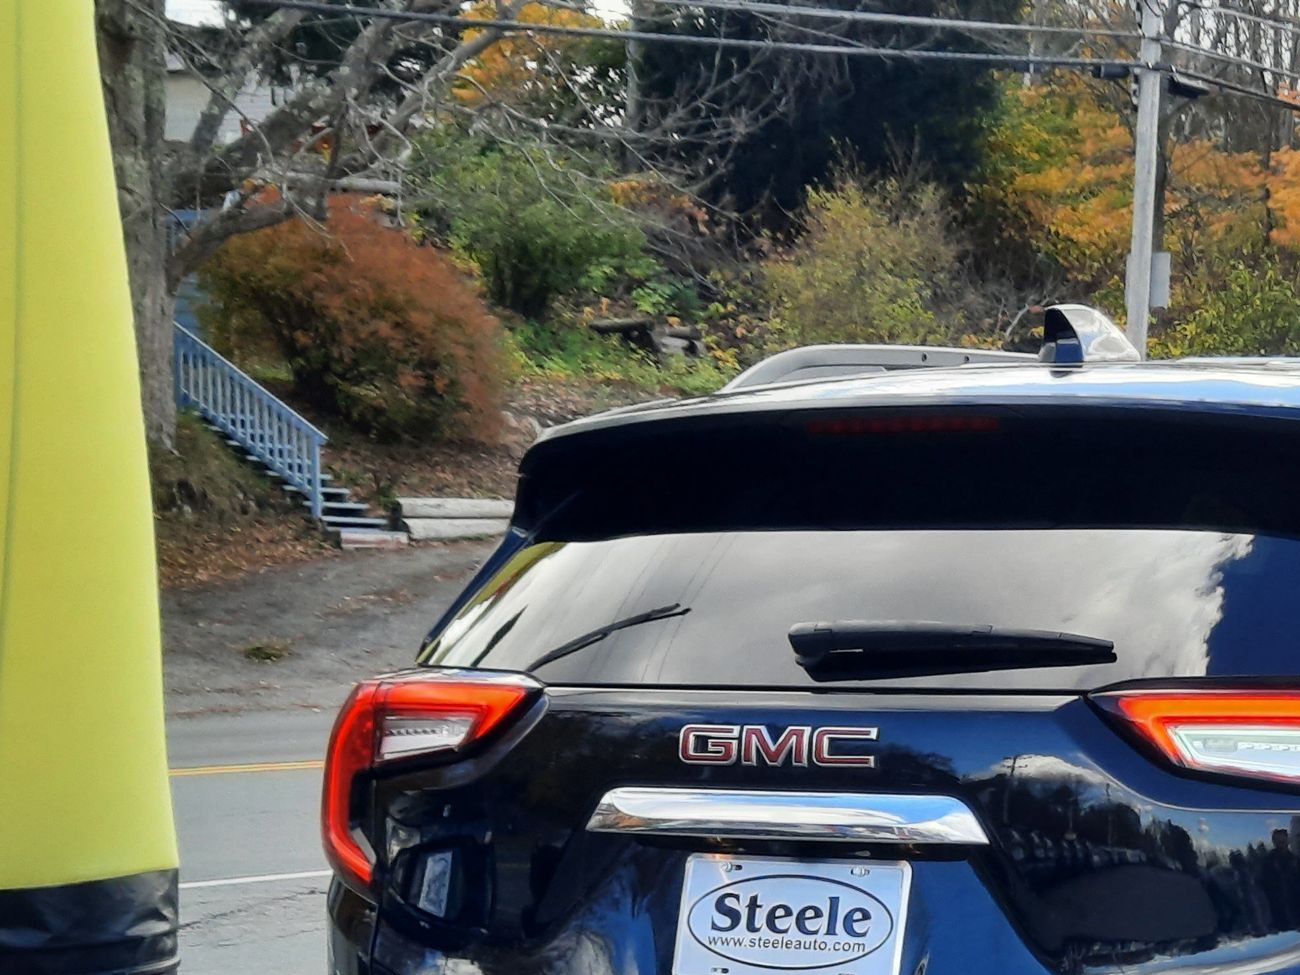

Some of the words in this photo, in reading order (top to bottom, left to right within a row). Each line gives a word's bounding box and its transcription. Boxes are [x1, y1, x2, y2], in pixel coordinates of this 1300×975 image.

[679, 724, 879, 768] GMC
[711, 893, 871, 938] Steele
[708, 935, 866, 953] www.steeleauto.com
